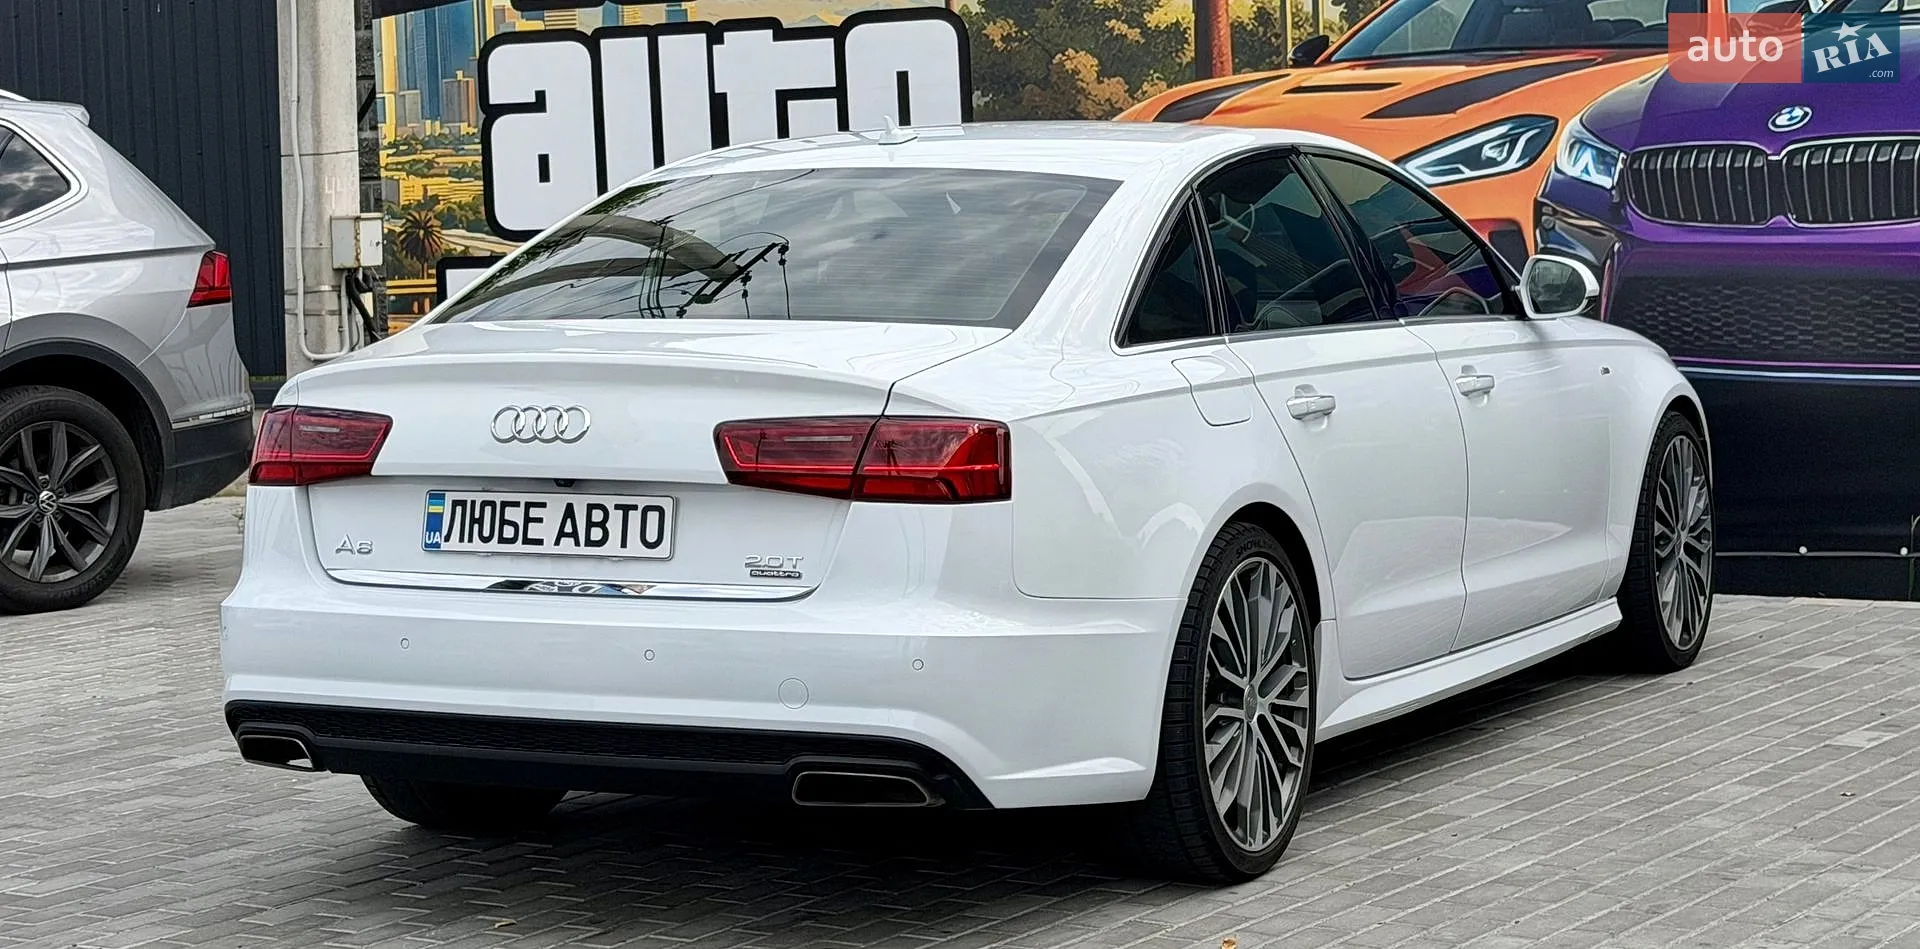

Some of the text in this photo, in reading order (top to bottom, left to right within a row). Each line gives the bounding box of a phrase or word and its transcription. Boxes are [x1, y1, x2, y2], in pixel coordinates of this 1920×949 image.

[443, 499, 666, 550] ЛЮБЕ АВТО
[335, 534, 373, 555] A6
[425, 531, 441, 544] UA
[751, 570, 800, 578] quattro
